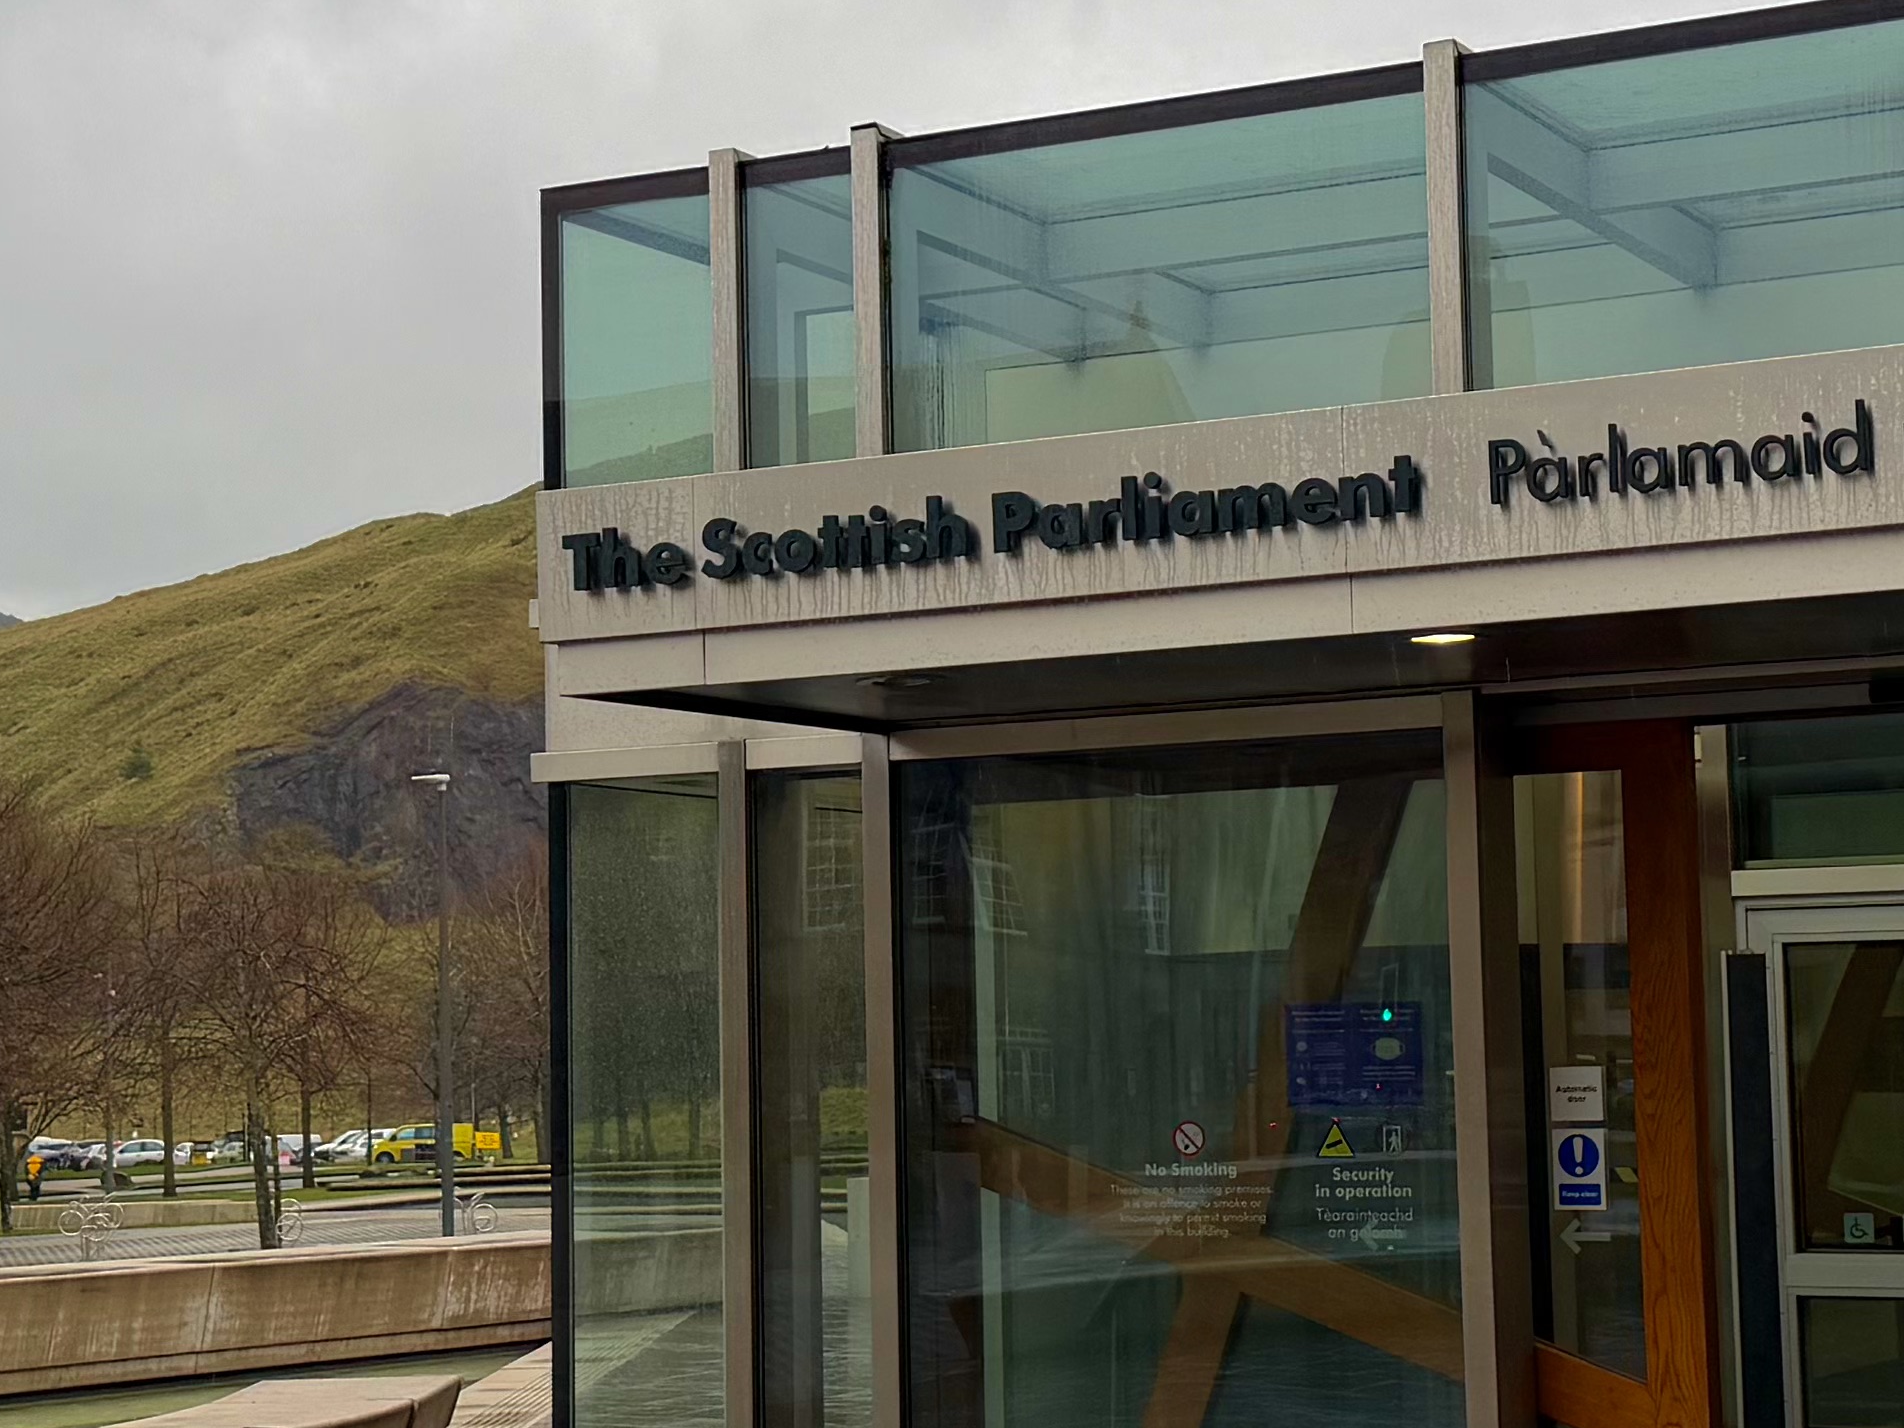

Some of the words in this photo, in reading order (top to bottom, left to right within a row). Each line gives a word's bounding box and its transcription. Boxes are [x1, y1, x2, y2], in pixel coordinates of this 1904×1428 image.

[562, 527, 691, 592] The
[701, 496, 975, 579] Scottish
[992, 455, 1423, 554] Parliament
[1487, 399, 1875, 506] Pàrlamaid
[1145, 1163, 1167, 1176] No
[1171, 1162, 1238, 1178] Smoking
[1332, 1167, 1394, 1184] Security
[1315, 1184, 1330, 1197] in
[1336, 1184, 1412, 1200] operation
[1316, 1207, 1414, 1221] Tèarainteachd
[1328, 1228, 1345, 1238] an
